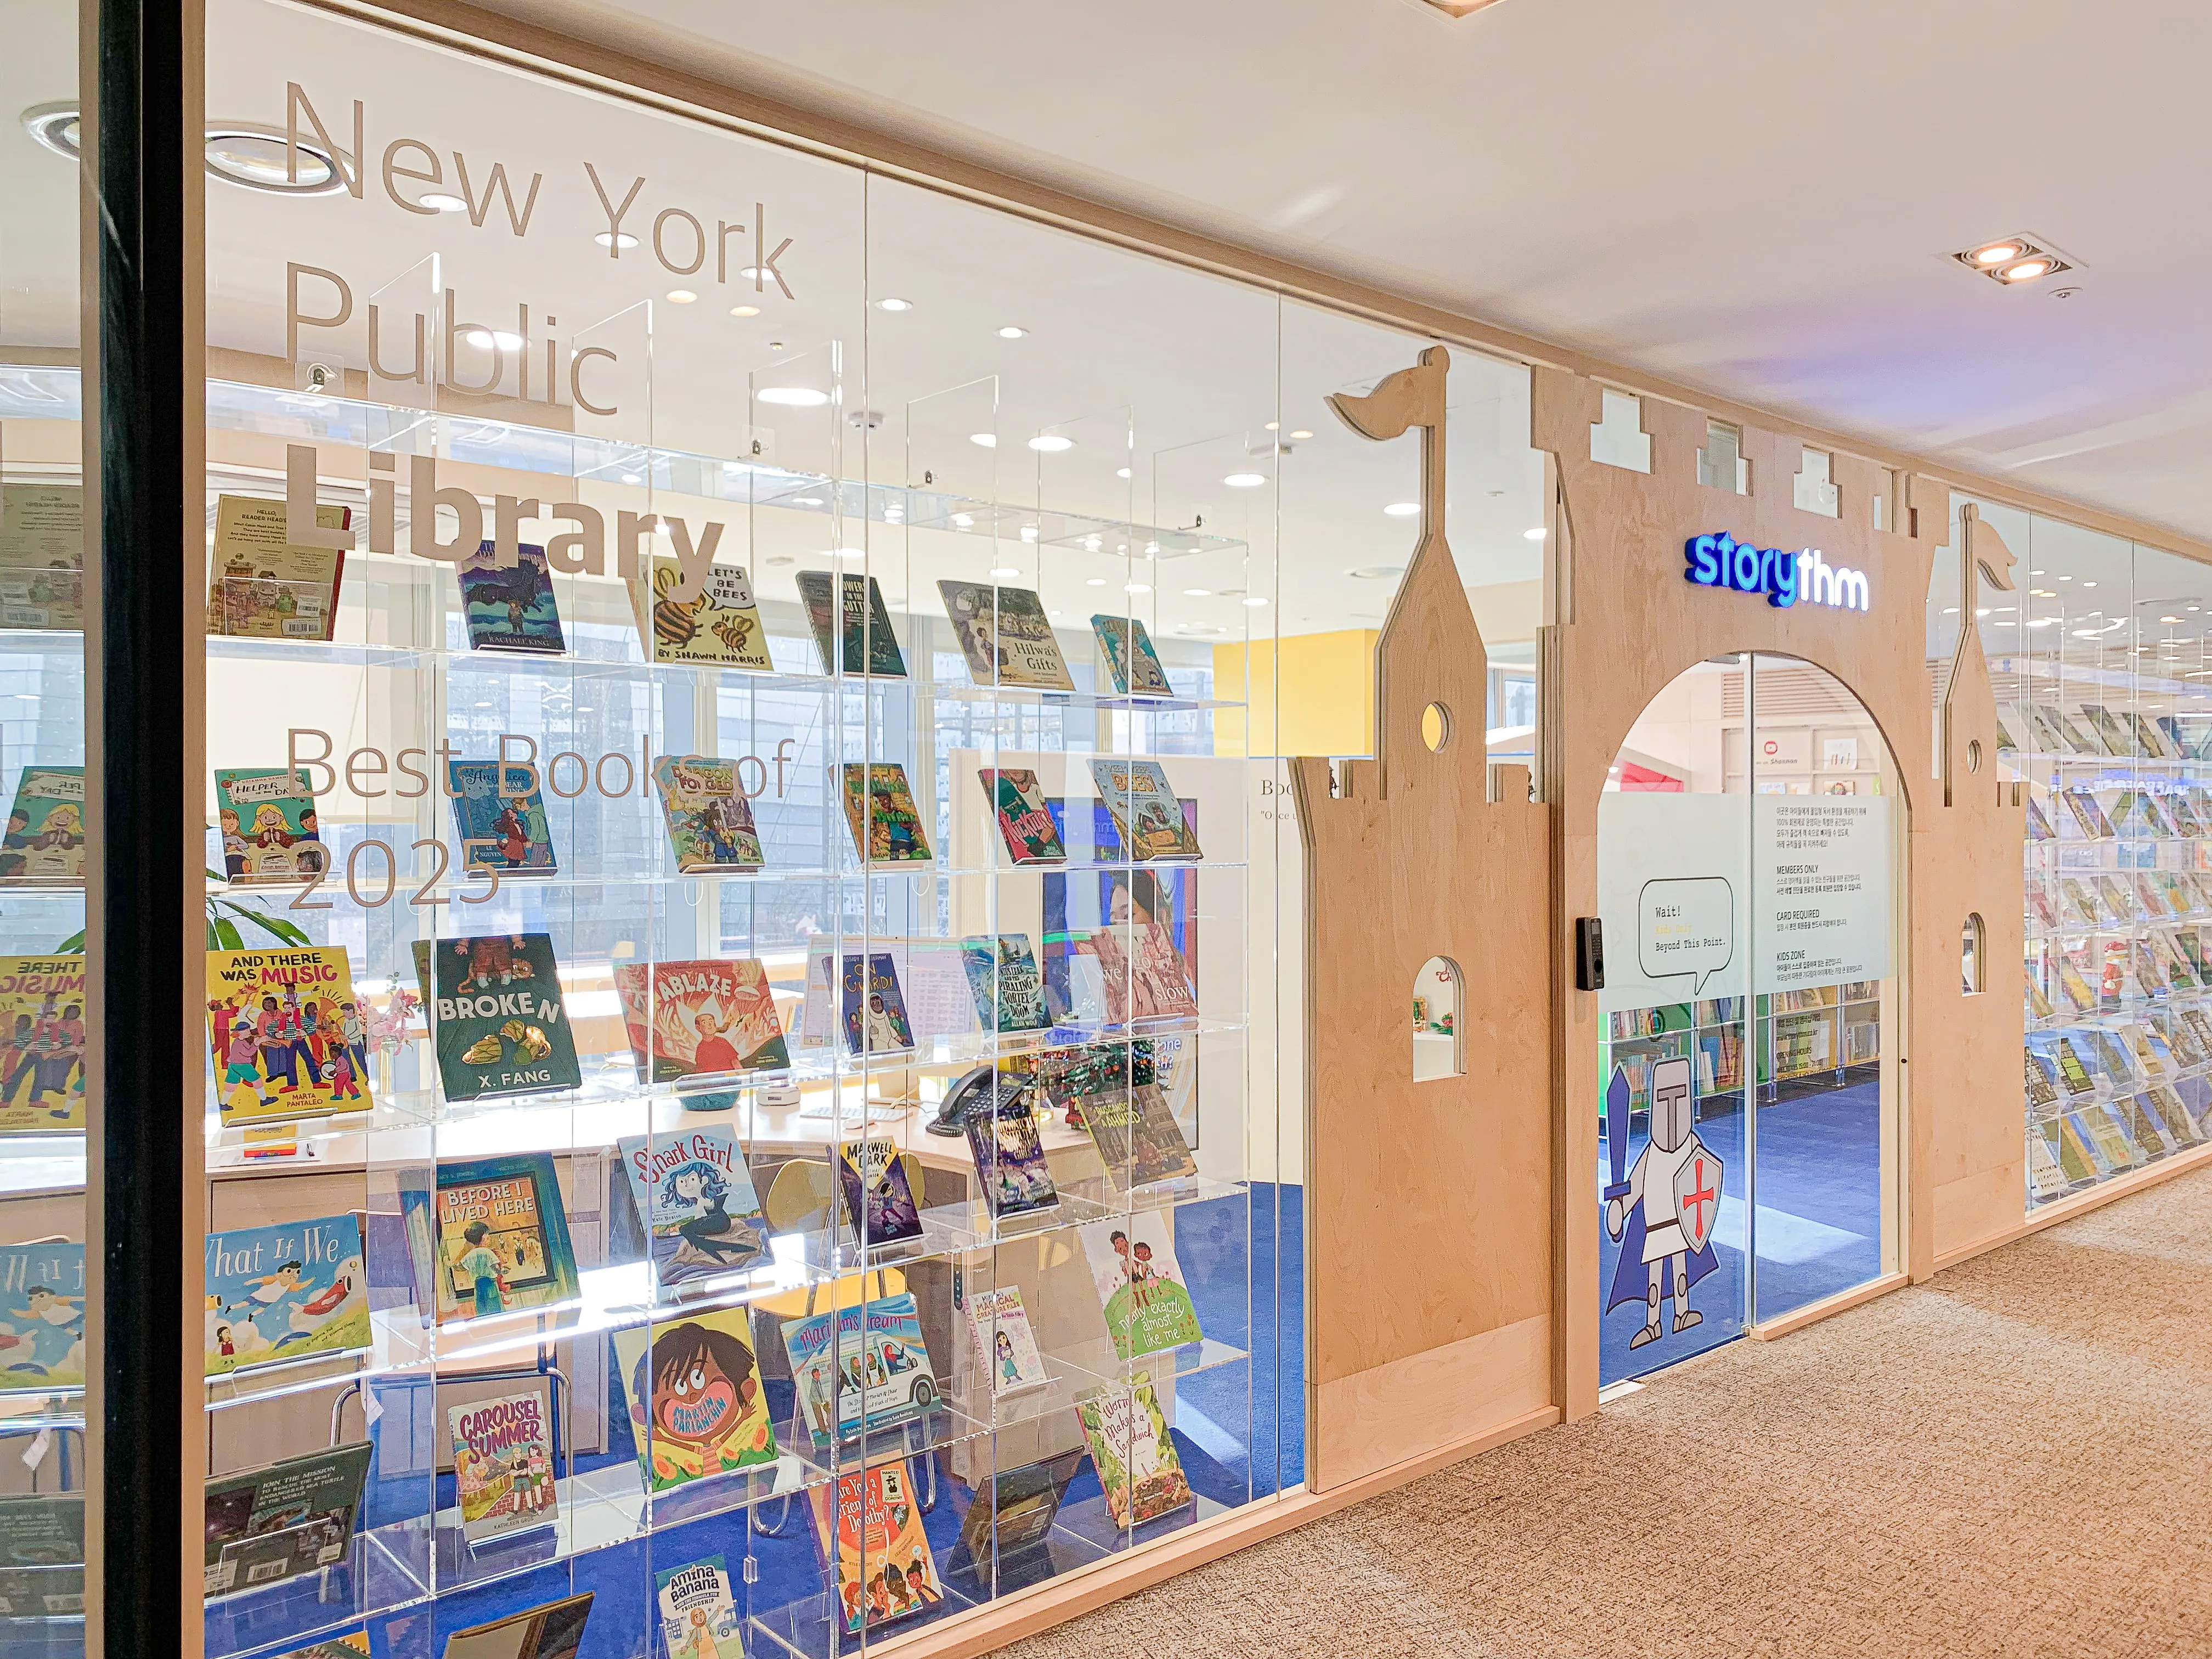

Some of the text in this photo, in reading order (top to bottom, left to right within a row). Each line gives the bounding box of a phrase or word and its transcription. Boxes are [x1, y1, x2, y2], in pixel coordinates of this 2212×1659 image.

[286, 81, 795, 301] New York
[286, 262, 618, 416] Public
[286, 444, 724, 603] Library
[708, 568, 742, 580] LET'S
[1686, 531, 1869, 612] storythm
[713, 589, 748, 601] BEES
[528, 637, 549, 646] KING
[1014, 642, 1057, 657] Hilwa's
[658, 648, 765, 665] BY SHAWN HARRIS
[1026, 657, 1057, 670] Gifts
[287, 728, 795, 798] Best Books of
[466, 769, 527, 784] Anglica
[236, 782, 278, 793] HELPER
[289, 838, 498, 910] 2025
[1776, 865, 1819, 874] MEMBERS ONLY
[1656, 905, 1680, 918] Wait!
[1776, 909, 1820, 921] CARD REQUIRED
[1656, 937, 1725, 953] Beyond This Point.
[232, 952, 323, 968] AND THERE
[1776, 950, 1805, 961] KIDS ZONE
[220, 964, 338, 984] WAS MUSIC
[854, 961, 876, 976] ON
[1103, 968, 1124, 980] we
[658, 973, 732, 1002] ABLAZE
[998, 976, 1032, 991] PIRALING
[1003, 991, 1030, 1005] VORTEX
[1154, 986, 1190, 1001] slow
[438, 991, 560, 1024] BROKEN
[1009, 1005, 1029, 1018] DOOM
[479, 1068, 551, 1088] X. FANG
[286, 1098, 323, 1107] PANTALEO
[634, 1134, 733, 1183] Shark Girl
[447, 1182, 522, 1206] BEFORE I
[442, 1197, 535, 1224] LIVED HERE
[274, 1238, 294, 1258] If
[1118, 1296, 1185, 1330] nearly exactly
[1141, 1314, 1173, 1332] almost
[1143, 1328, 1181, 1348] like me
[1103, 1398, 1128, 1418] Worm
[460, 1398, 541, 1441] CAROUSEL
[1104, 1413, 1136, 1441] Makes
[468, 1421, 543, 1464] SUMMER
[1115, 1422, 1154, 1458] Sandwich
[870, 1478, 877, 1488] a
[868, 1491, 878, 1509] of
[671, 1567, 715, 1590] Amina
[670, 1578, 719, 1603] Banana
[681, 1598, 714, 1613] FRIENDSHIP
